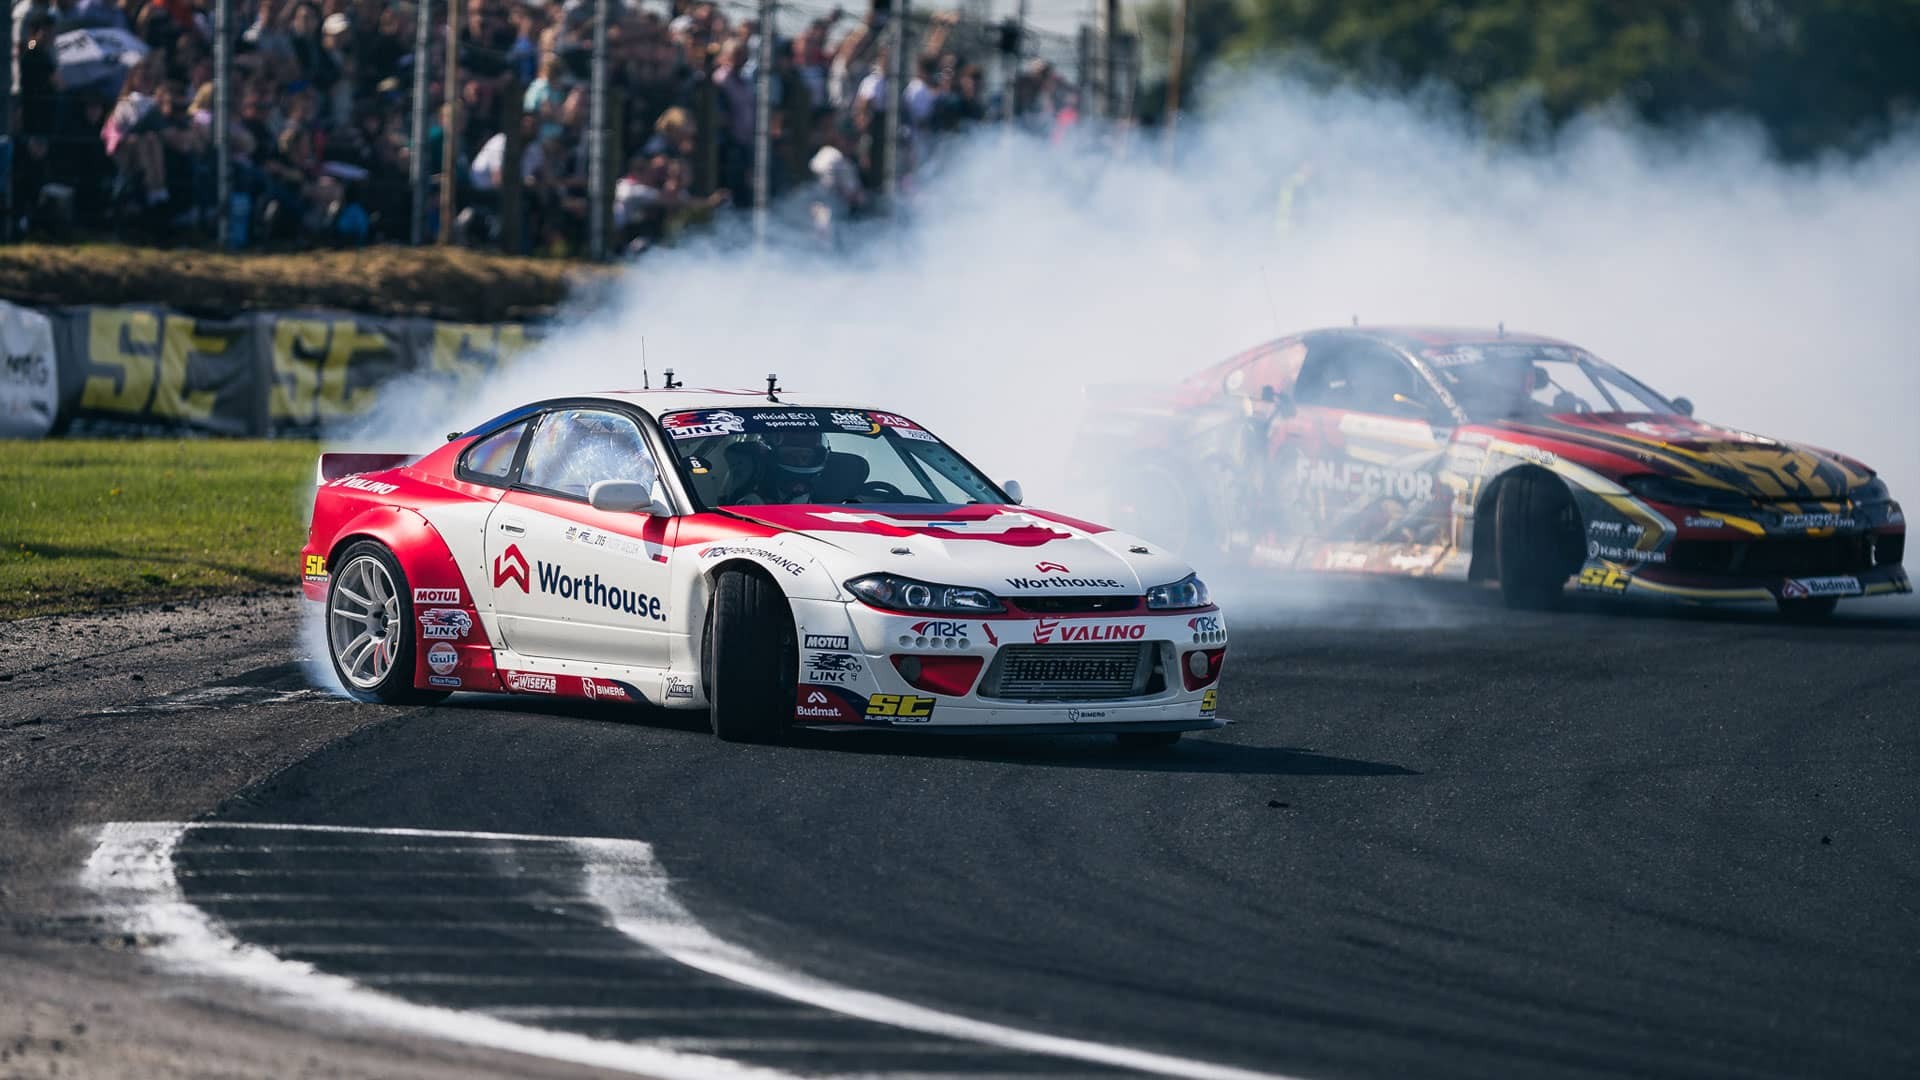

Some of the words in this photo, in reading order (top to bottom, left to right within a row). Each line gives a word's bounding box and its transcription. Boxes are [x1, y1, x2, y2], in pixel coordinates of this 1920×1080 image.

[753, 412, 788, 420] official
[788, 412, 816, 420] ECU
[876, 414, 910, 427] 215
[671, 425, 723, 436] LINK
[342, 478, 401, 495] VALINO
[1005, 577, 1126, 589] Worthouse.
[416, 591, 457, 601] MOTUL
[537, 559, 667, 622] Worthouse.
[425, 626, 458, 636] LINK
[1060, 624, 1146, 641] VALINO
[806, 636, 848, 648] MOTUL
[430, 653, 457, 663] Gulf
[810, 671, 846, 681] LINK
[518, 675, 557, 691] WISEFAB
[596, 686, 625, 697] BIMERG
[797, 706, 842, 717] Budmat.
